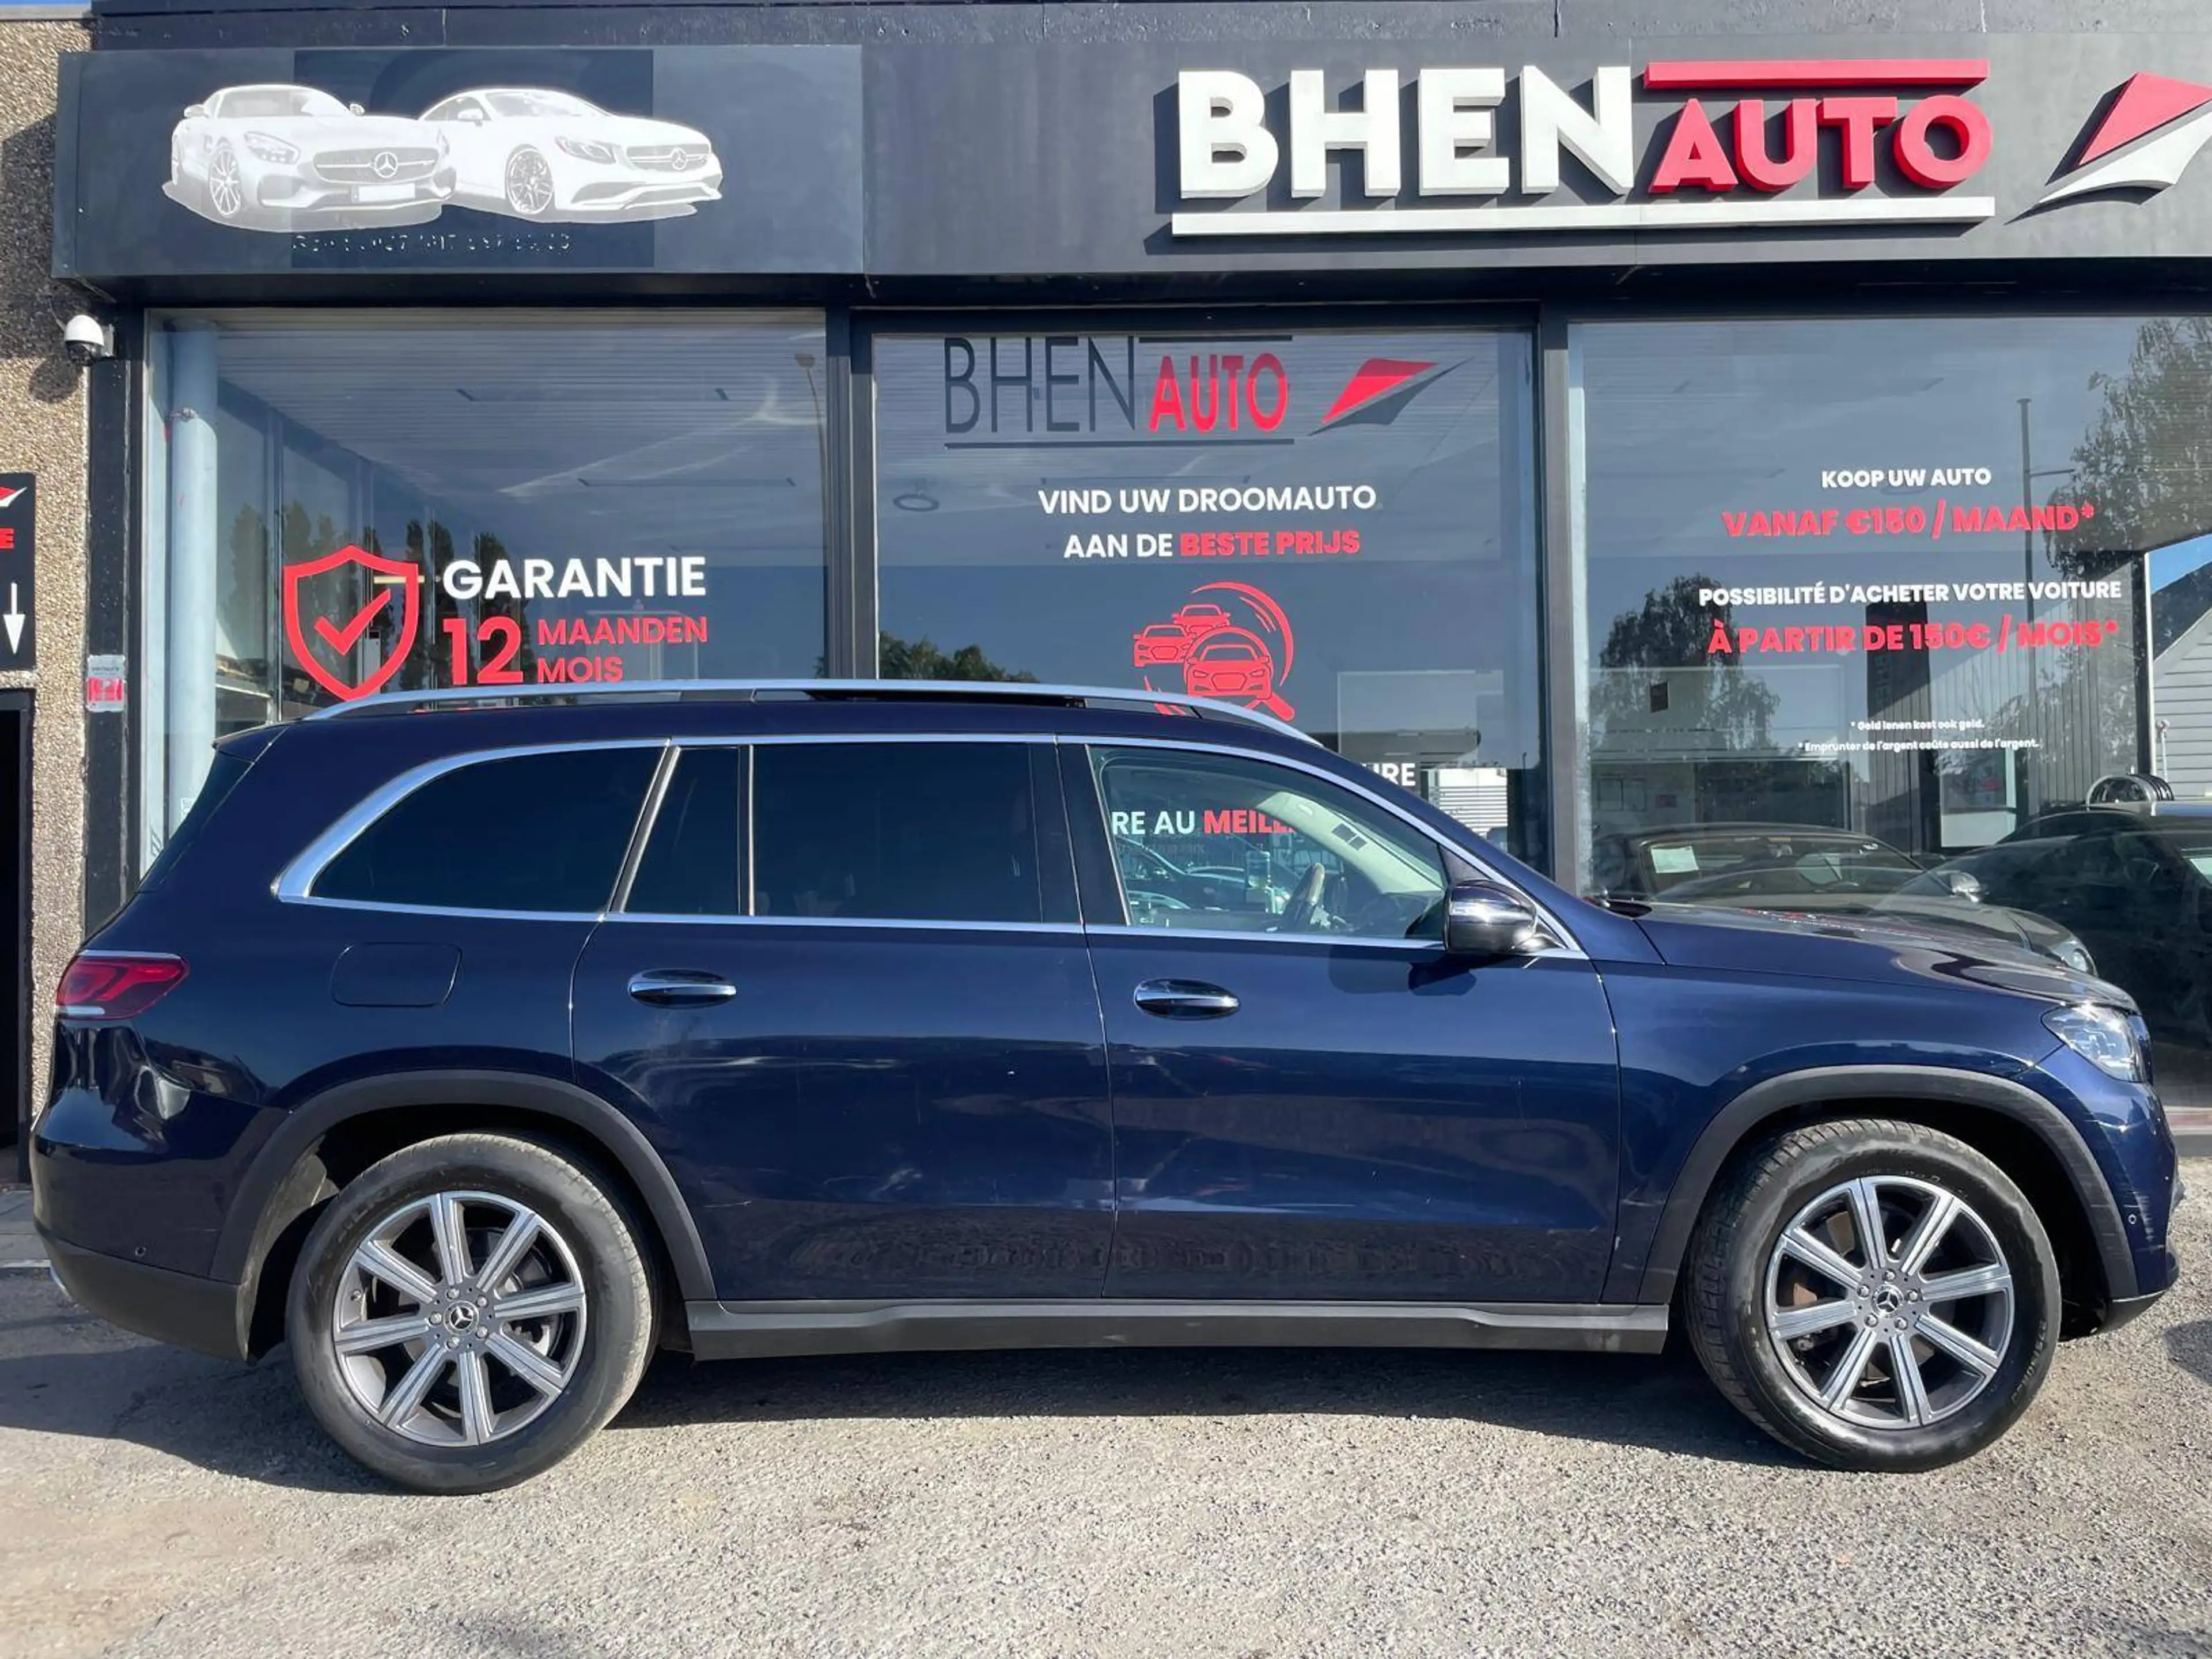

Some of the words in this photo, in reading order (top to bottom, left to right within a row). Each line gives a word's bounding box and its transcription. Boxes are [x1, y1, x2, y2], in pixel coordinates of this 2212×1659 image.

[1179, 65, 1634, 198] BHEN
[1649, 94, 1993, 193] AUTO
[944, 336, 1135, 433] BHEN
[1149, 352, 1288, 434] AUTO
[1821, 470, 1884, 488] KOOP
[1888, 469, 1927, 487] UW
[1931, 468, 1993, 486] AUTO
[1038, 491, 1112, 514] VIND
[1120, 490, 1171, 513] UW
[1179, 486, 1377, 513] DROOMAUTO
[1722, 510, 1839, 537] VANAF
[1845, 507, 1926, 535] €150
[1064, 535, 1128, 558] AAN
[1137, 534, 1173, 557] DE
[1180, 532, 1270, 557] BESTE
[1275, 531, 1361, 555] PRIJS
[443, 556, 706, 600] GARANTIE
[1699, 582, 1825, 607] POSSIBILITÉ
[1830, 584, 1949, 604] D'ACHETER
[1952, 584, 2026, 601] VOTRE
[2028, 581, 2122, 600] VOITURE
[537, 617, 708, 646] MAANDEN
[1707, 619, 1732, 654] À
[1737, 626, 1856, 653] PARTIR
[1862, 624, 1904, 652] DE
[1909, 622, 1990, 650] 150€
[442, 615, 524, 685] 12
[537, 656, 623, 683] MOIS
[1112, 811, 1146, 835] RE
[1154, 810, 1195, 835] AU
[1204, 810, 1295, 834] MEILL
